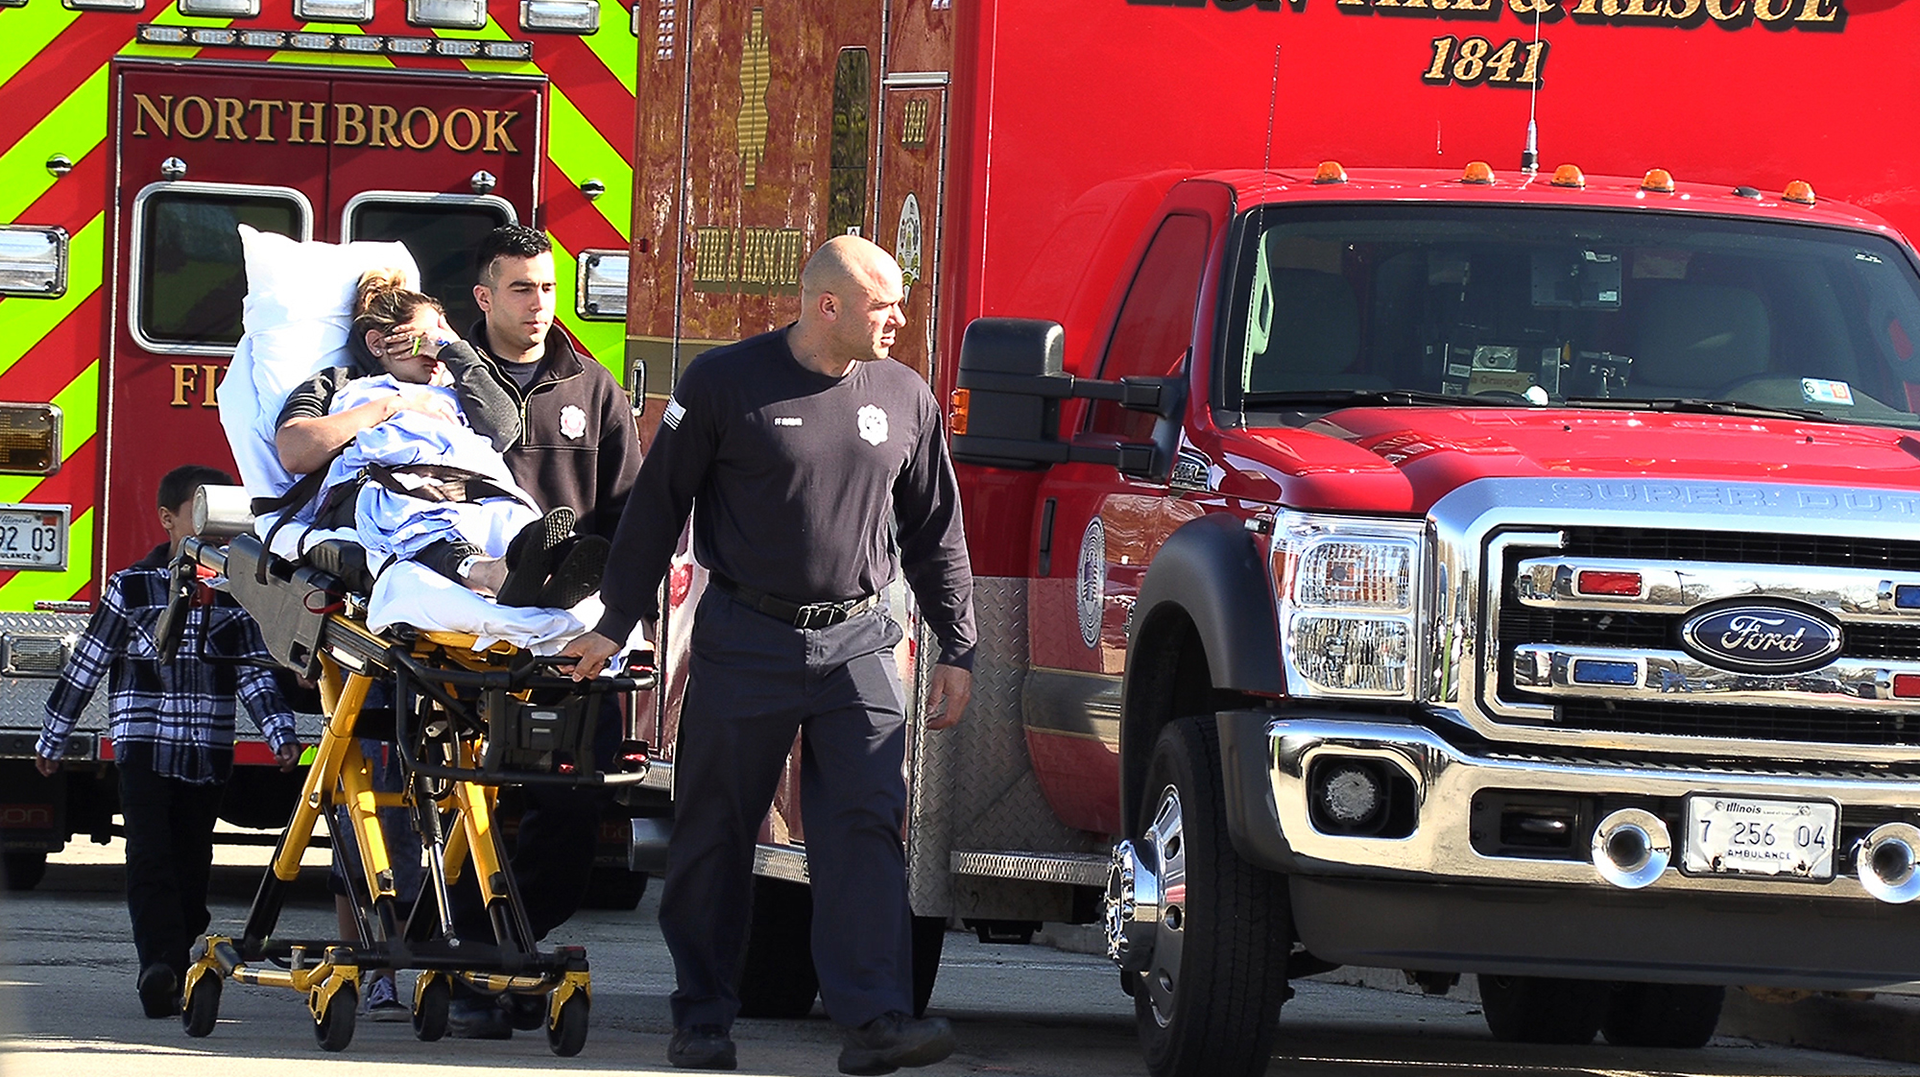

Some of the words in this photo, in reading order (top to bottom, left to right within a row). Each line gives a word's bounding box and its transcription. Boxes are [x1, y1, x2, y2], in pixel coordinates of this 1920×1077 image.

[1424, 37, 1546, 83] 1841
[132, 93, 520, 153] NORTHBROOK
[902, 101, 927, 142] 1841
[693, 227, 729, 281] FIRE
[740, 229, 801, 285] RESCUE
[170, 364, 229, 406] FI
[1551, 481, 1778, 508] SUPER
[1797, 489, 1920, 516] DUT
[32, 527, 56, 552] 03
[1720, 615, 1807, 652] Ford
[1726, 802, 1762, 815] Illinois
[1700, 819, 1712, 843] 7
[1733, 822, 1776, 846] 256
[1797, 825, 1826, 848] 04
[1727, 849, 1792, 860] AMBULANCE
